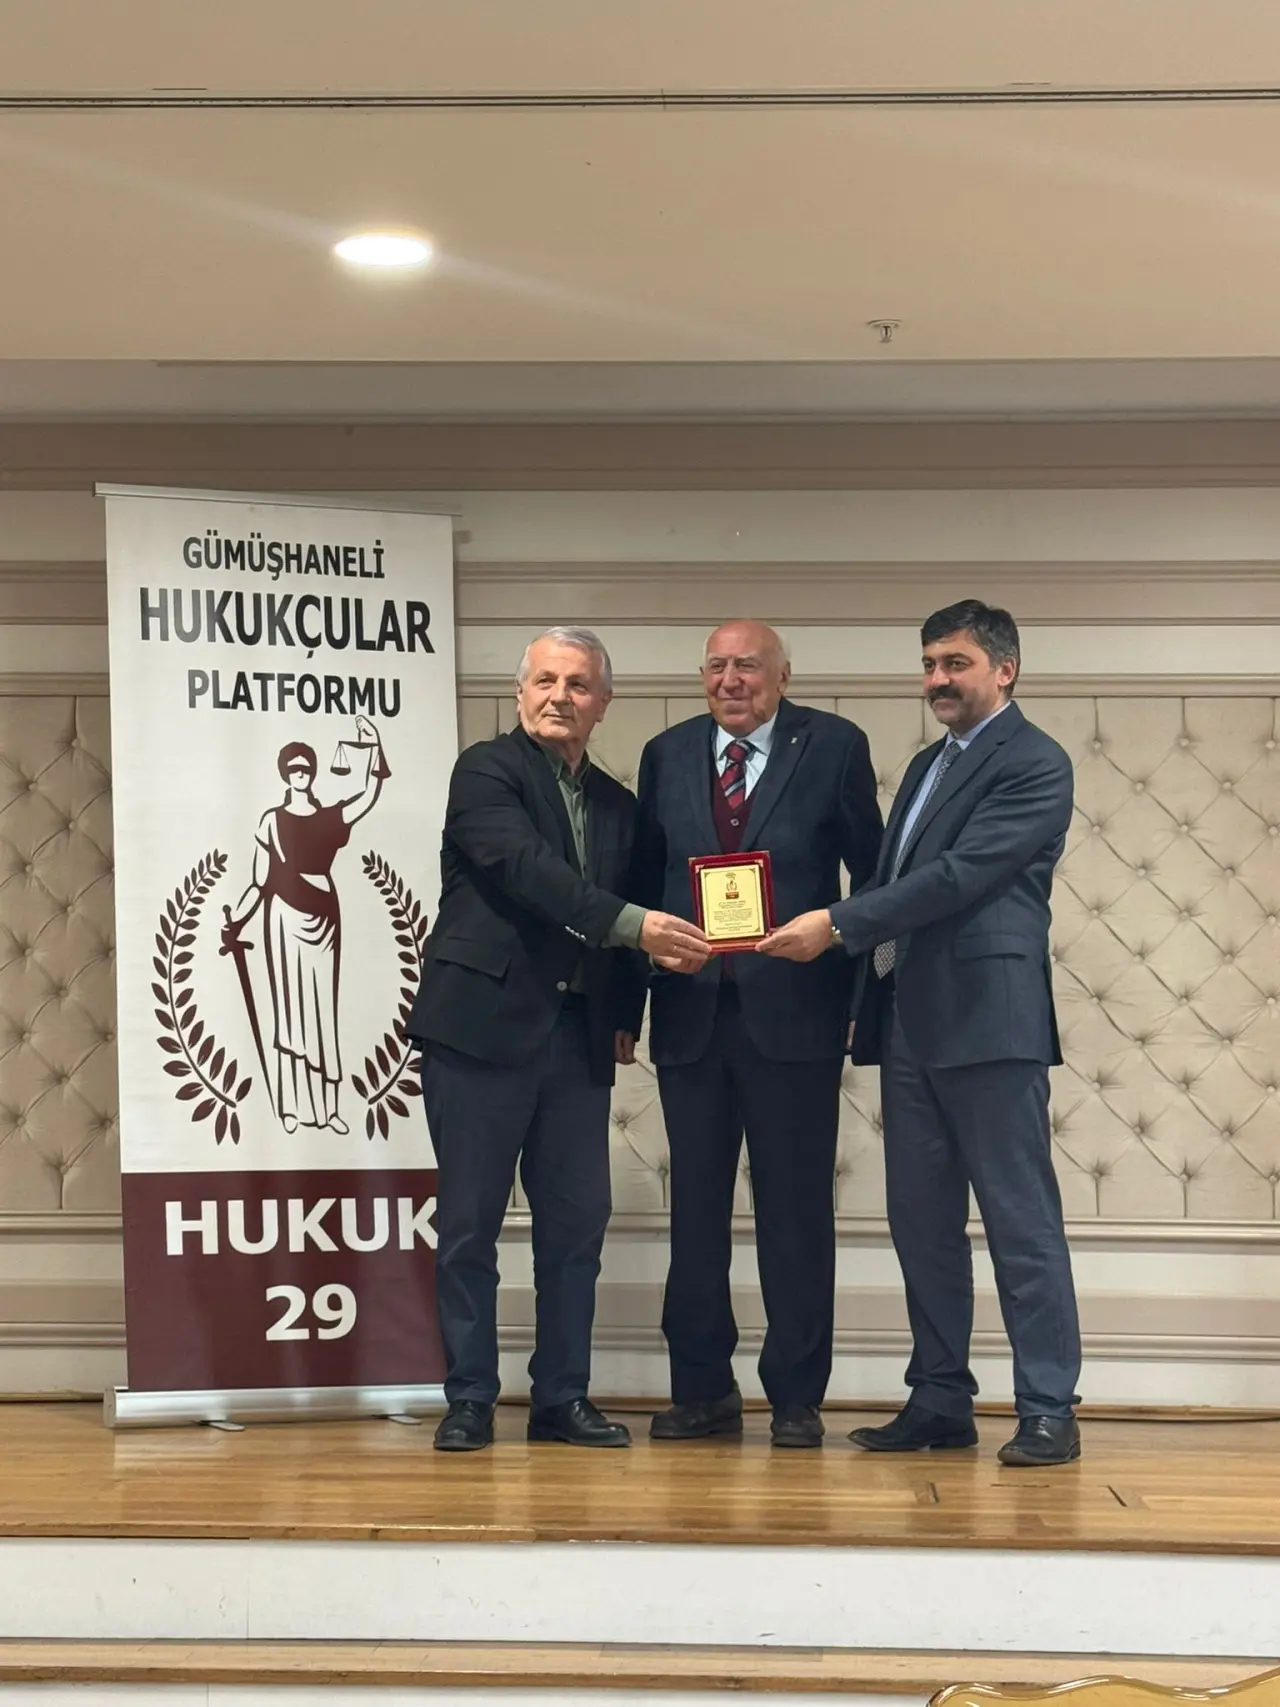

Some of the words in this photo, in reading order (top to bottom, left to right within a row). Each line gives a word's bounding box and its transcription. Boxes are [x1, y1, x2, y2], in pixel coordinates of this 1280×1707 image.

[182, 529, 386, 581] GÜMÜŞHANELİ
[139, 587, 436, 659] HUKUKÇULAR
[188, 669, 402, 718] PLATFORMU
[165, 1196, 439, 1256] HUKUK
[265, 1283, 358, 1341] 29
